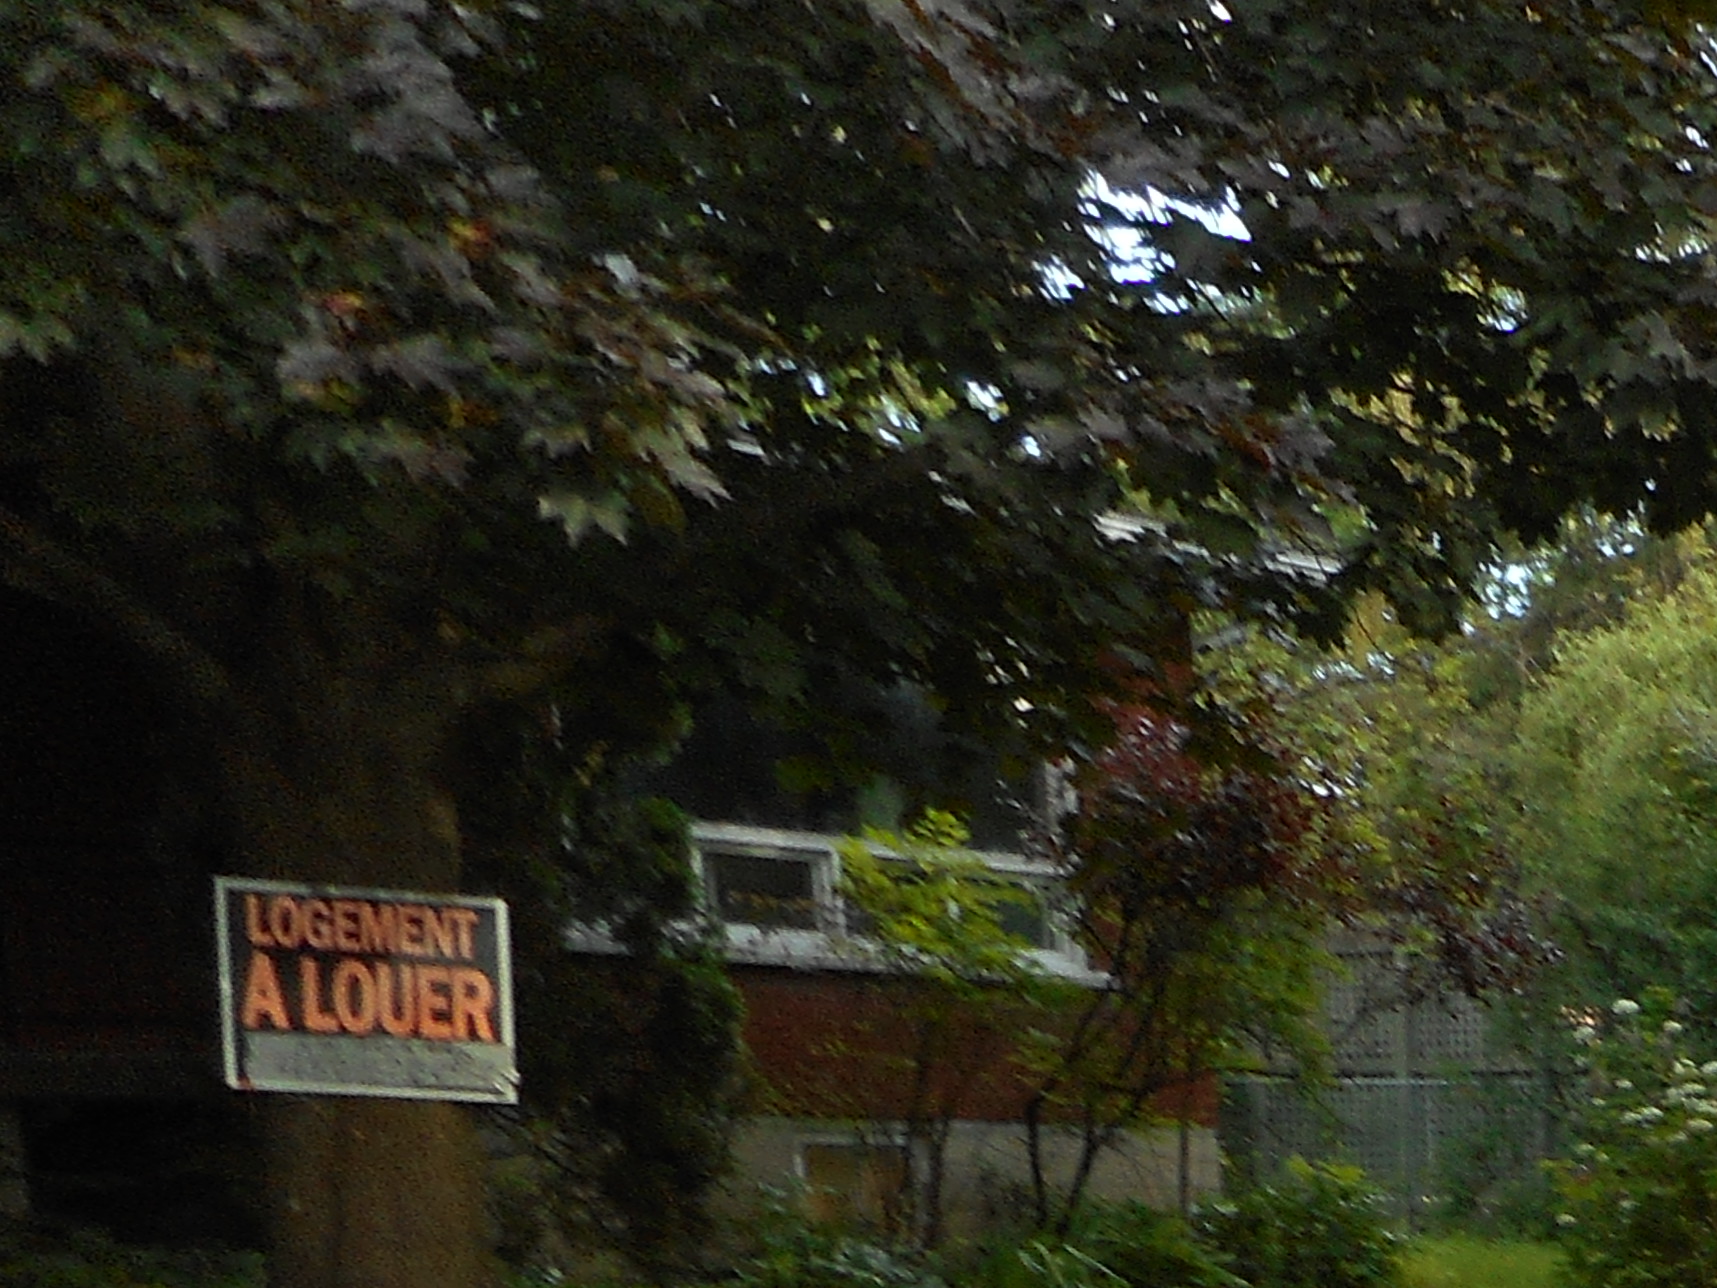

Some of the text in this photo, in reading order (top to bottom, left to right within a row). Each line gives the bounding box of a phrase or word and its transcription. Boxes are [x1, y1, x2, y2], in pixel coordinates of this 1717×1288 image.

[244, 892, 480, 959] LOGEMENT
[241, 951, 496, 1043] A LOUER
